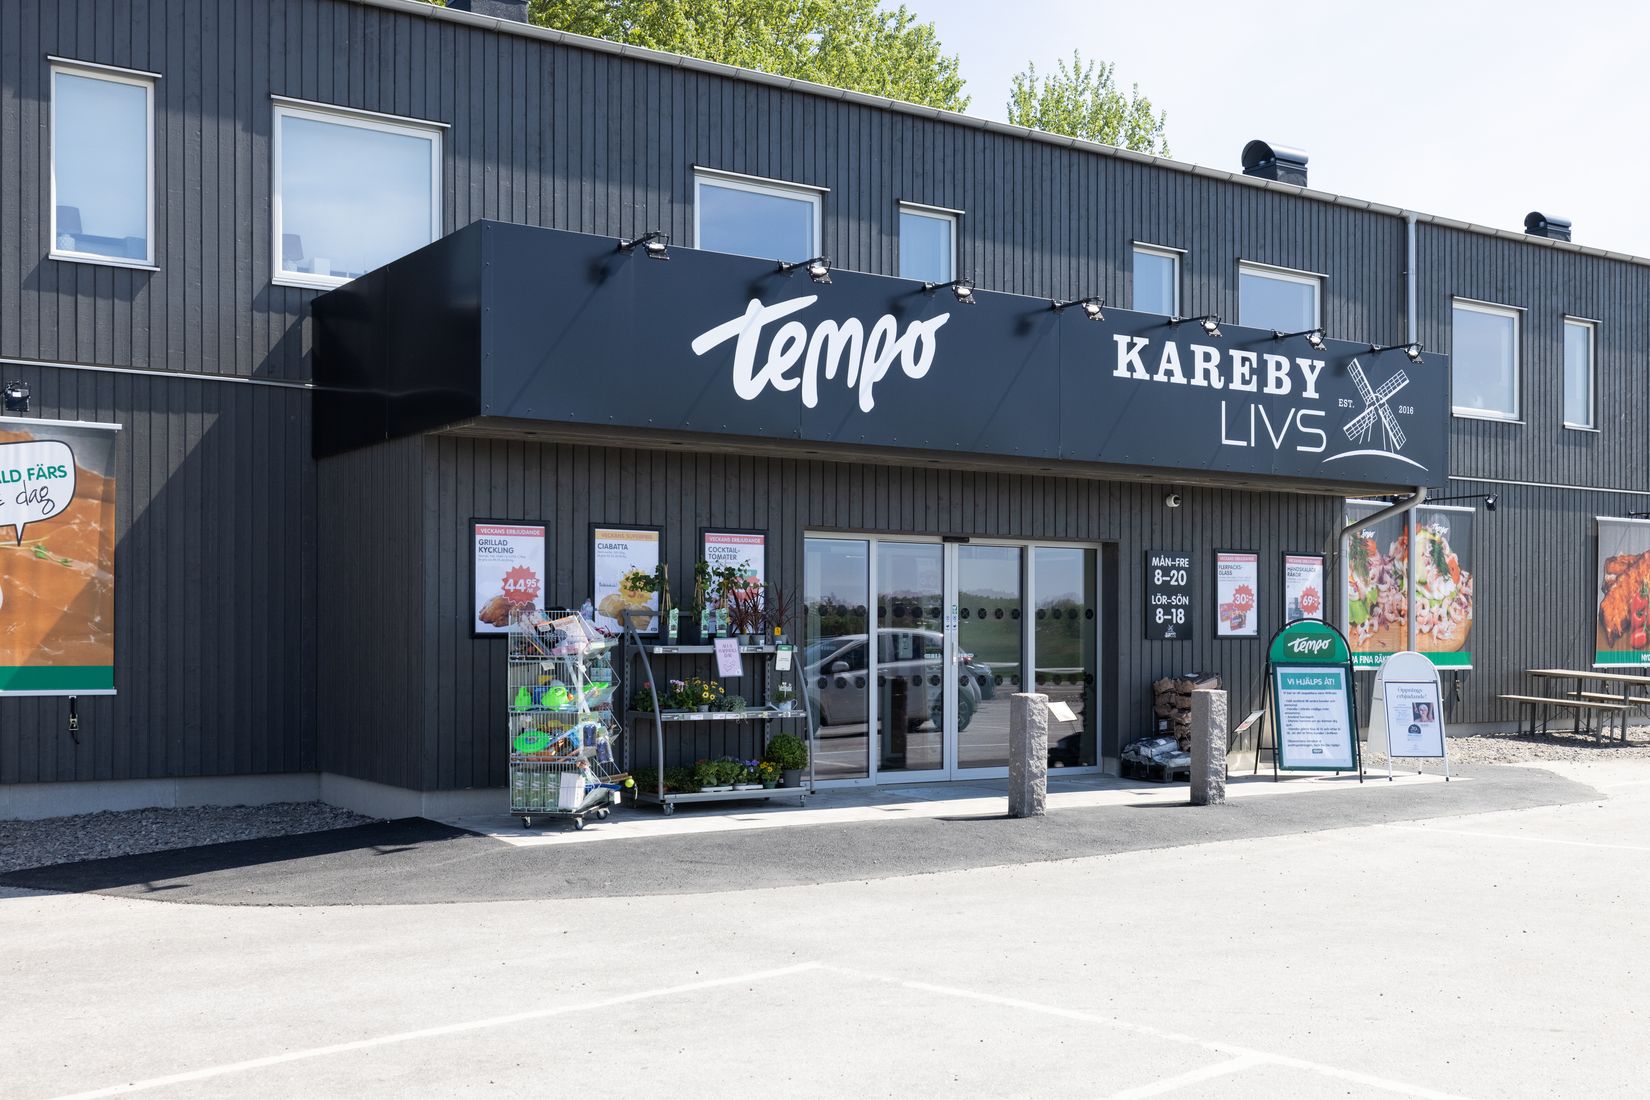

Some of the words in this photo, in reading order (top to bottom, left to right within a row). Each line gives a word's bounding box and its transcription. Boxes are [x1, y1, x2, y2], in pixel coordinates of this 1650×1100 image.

[1112, 333, 1326, 399] KAREBY
[1338, 398, 1355, 409] EST.
[1398, 405, 1414, 415] 2016
[1221, 400, 1327, 453] LIVS
[0, 469, 22, 484] LD
[26, 463, 68, 481] FÄRS
[16, 479, 56, 516] dag
[480, 527, 505, 535] VECKANS
[478, 538, 508, 547] GRILLAD
[597, 542, 629, 551] CIABATTA
[478, 546, 515, 554] KYCKLING
[708, 553, 737, 561] TOMATER
[1154, 569, 1187, 586] 8-20
[1155, 607, 1185, 624] 8-18
[1296, 676, 1323, 686] HJÄLPS
